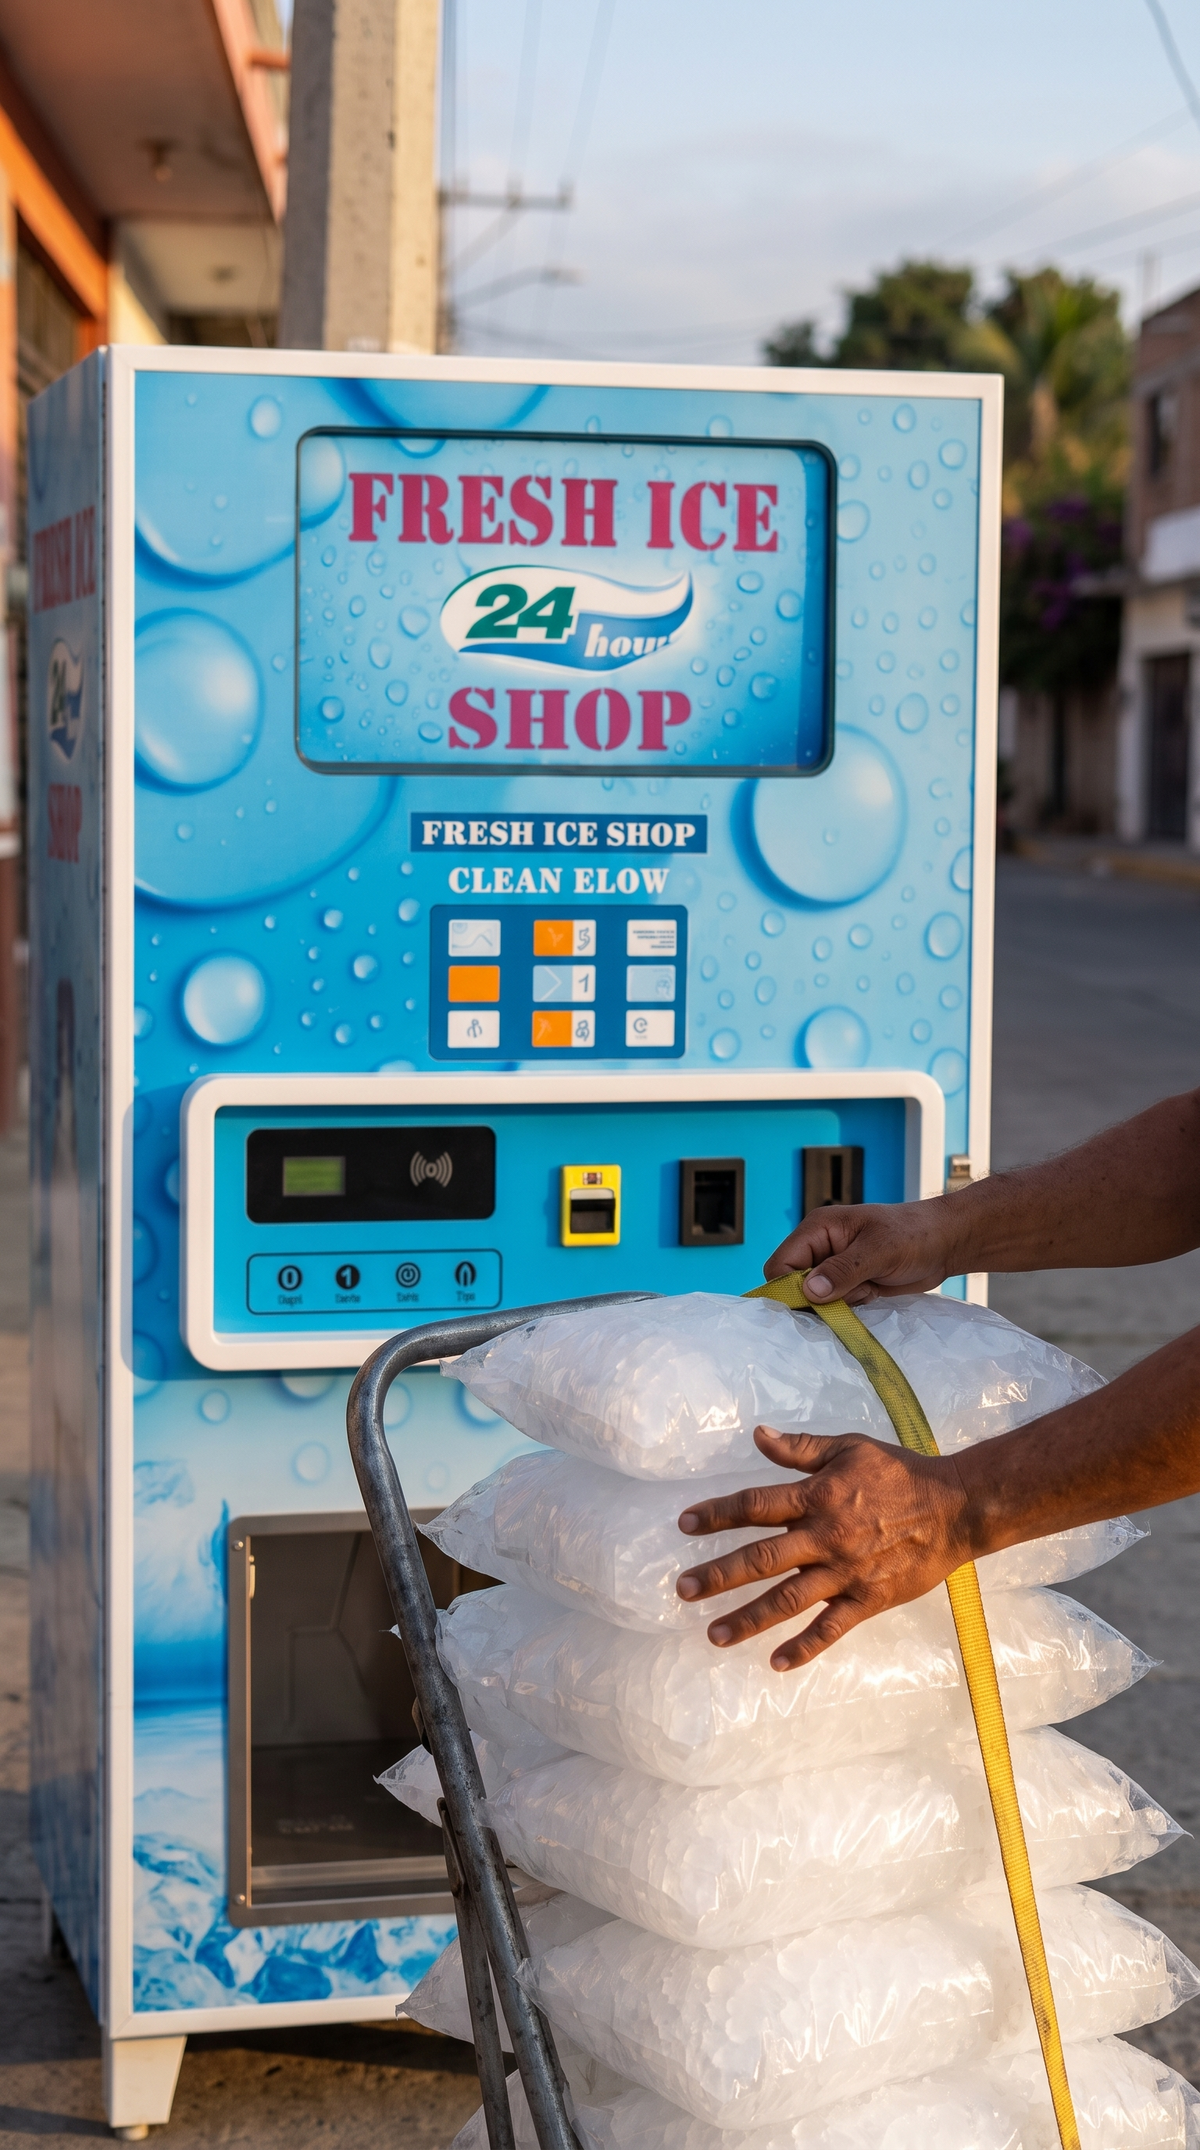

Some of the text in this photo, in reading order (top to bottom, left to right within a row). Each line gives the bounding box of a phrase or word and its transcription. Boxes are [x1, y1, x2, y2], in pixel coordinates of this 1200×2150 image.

[348, 472, 779, 553] FRESH ICE
[465, 583, 577, 640] 24
[447, 687, 693, 752] SHOP
[421, 820, 696, 847] FRESH ICE SHOP
[448, 867, 670, 894] CLEAN ELOW
